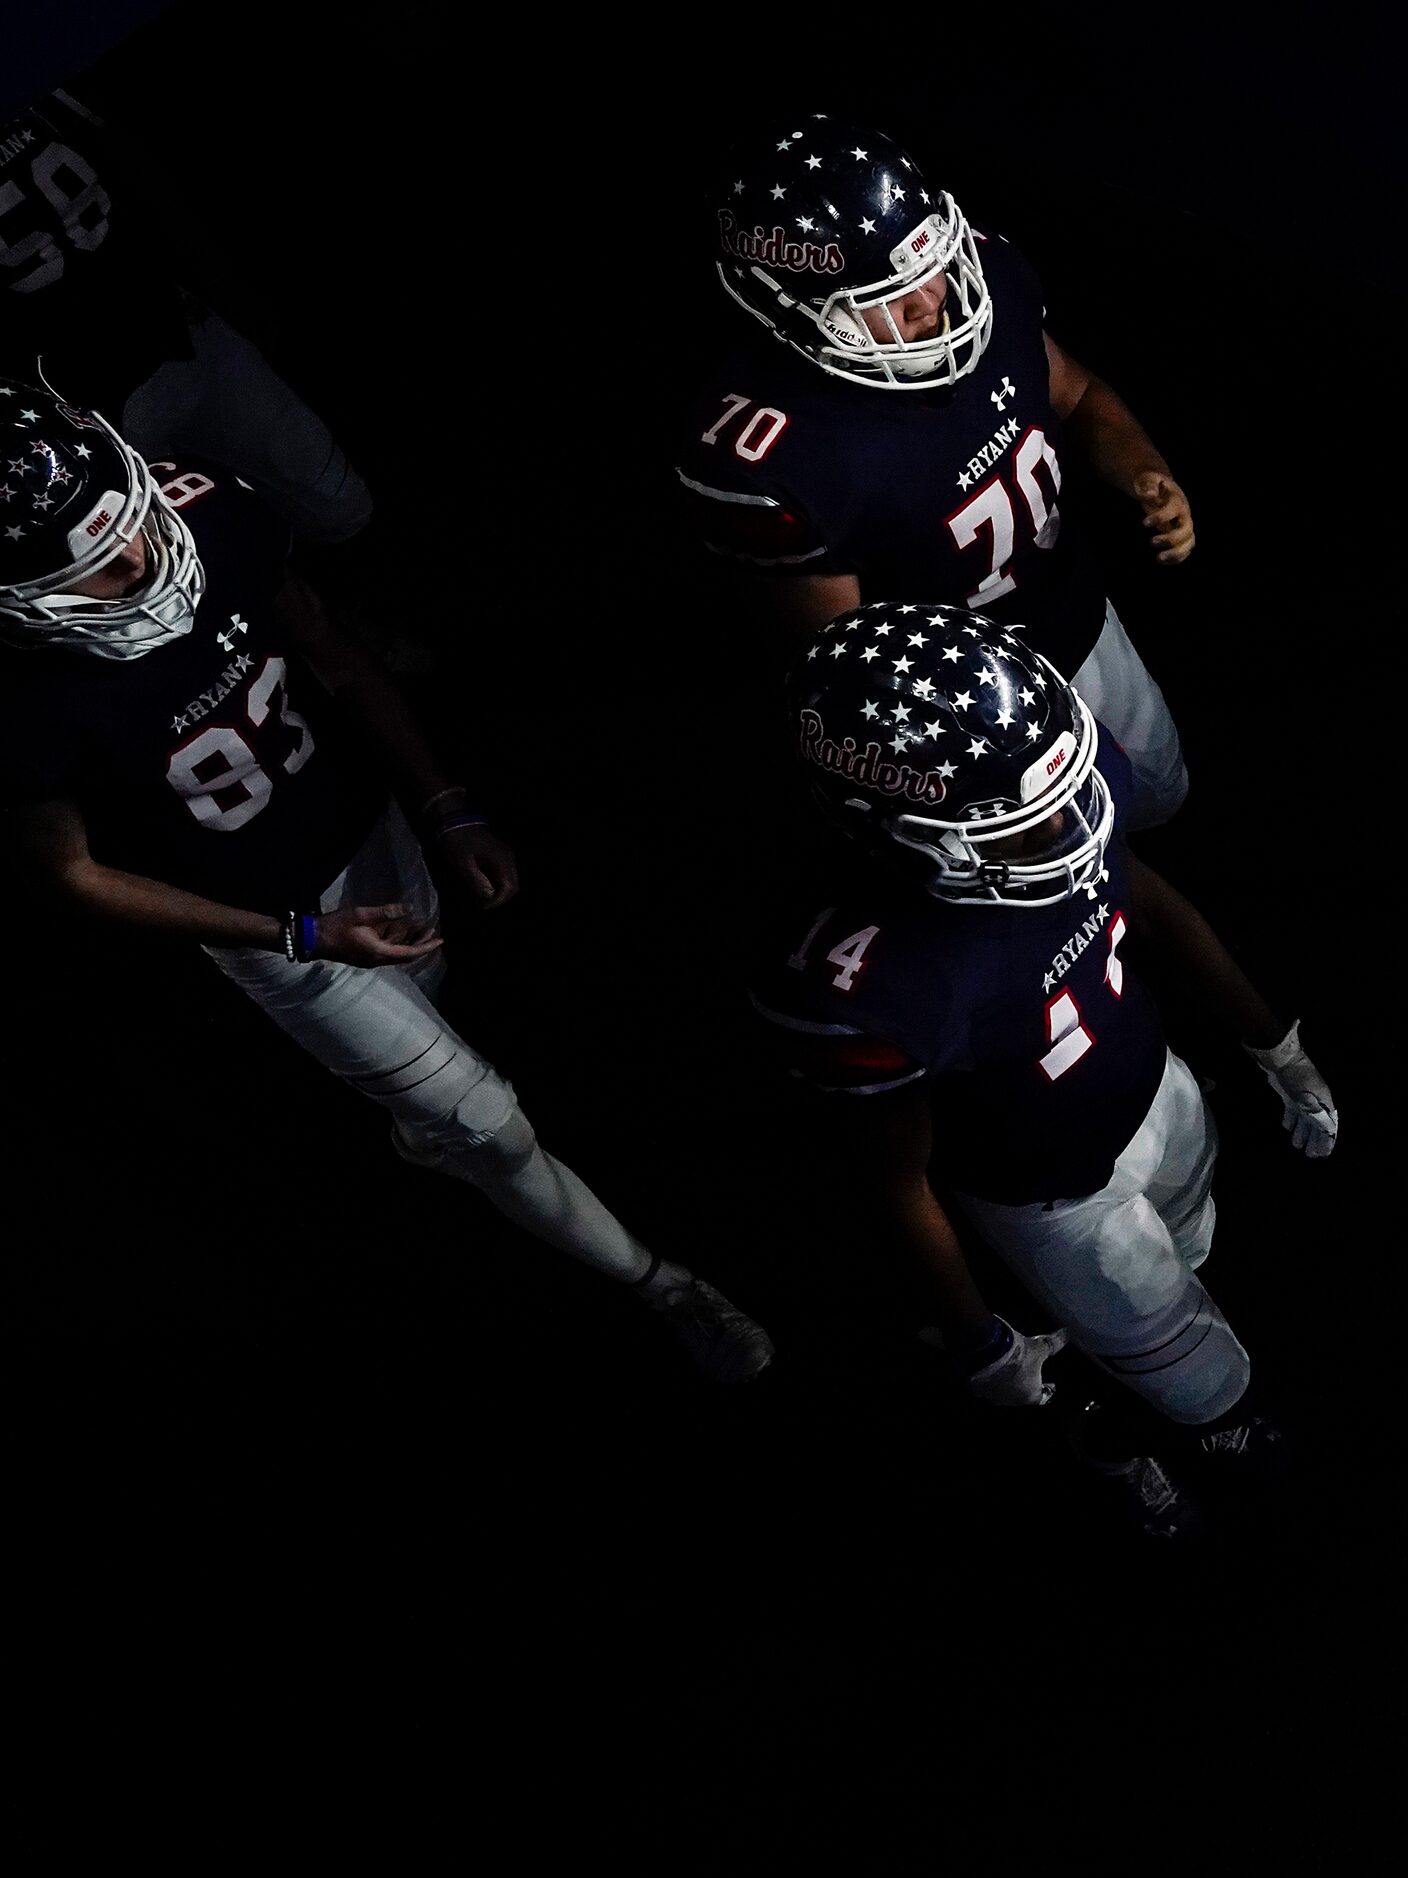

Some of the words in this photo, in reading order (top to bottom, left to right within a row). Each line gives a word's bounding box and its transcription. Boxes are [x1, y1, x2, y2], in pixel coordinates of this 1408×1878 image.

[717, 208, 845, 275] Raiders
[911, 231, 929, 252] ONE
[700, 392, 789, 462] 70
[967, 425, 1013, 480] RYAN
[86, 510, 112, 537] ONE
[944, 425, 1062, 610] 70
[185, 663, 243, 722] RYAN
[164, 656, 316, 832] 83
[800, 708, 946, 805] Raiders
[1046, 748, 1066, 776] ONE
[786, 907, 881, 991] 14
[1052, 913, 1100, 978] RYAN
